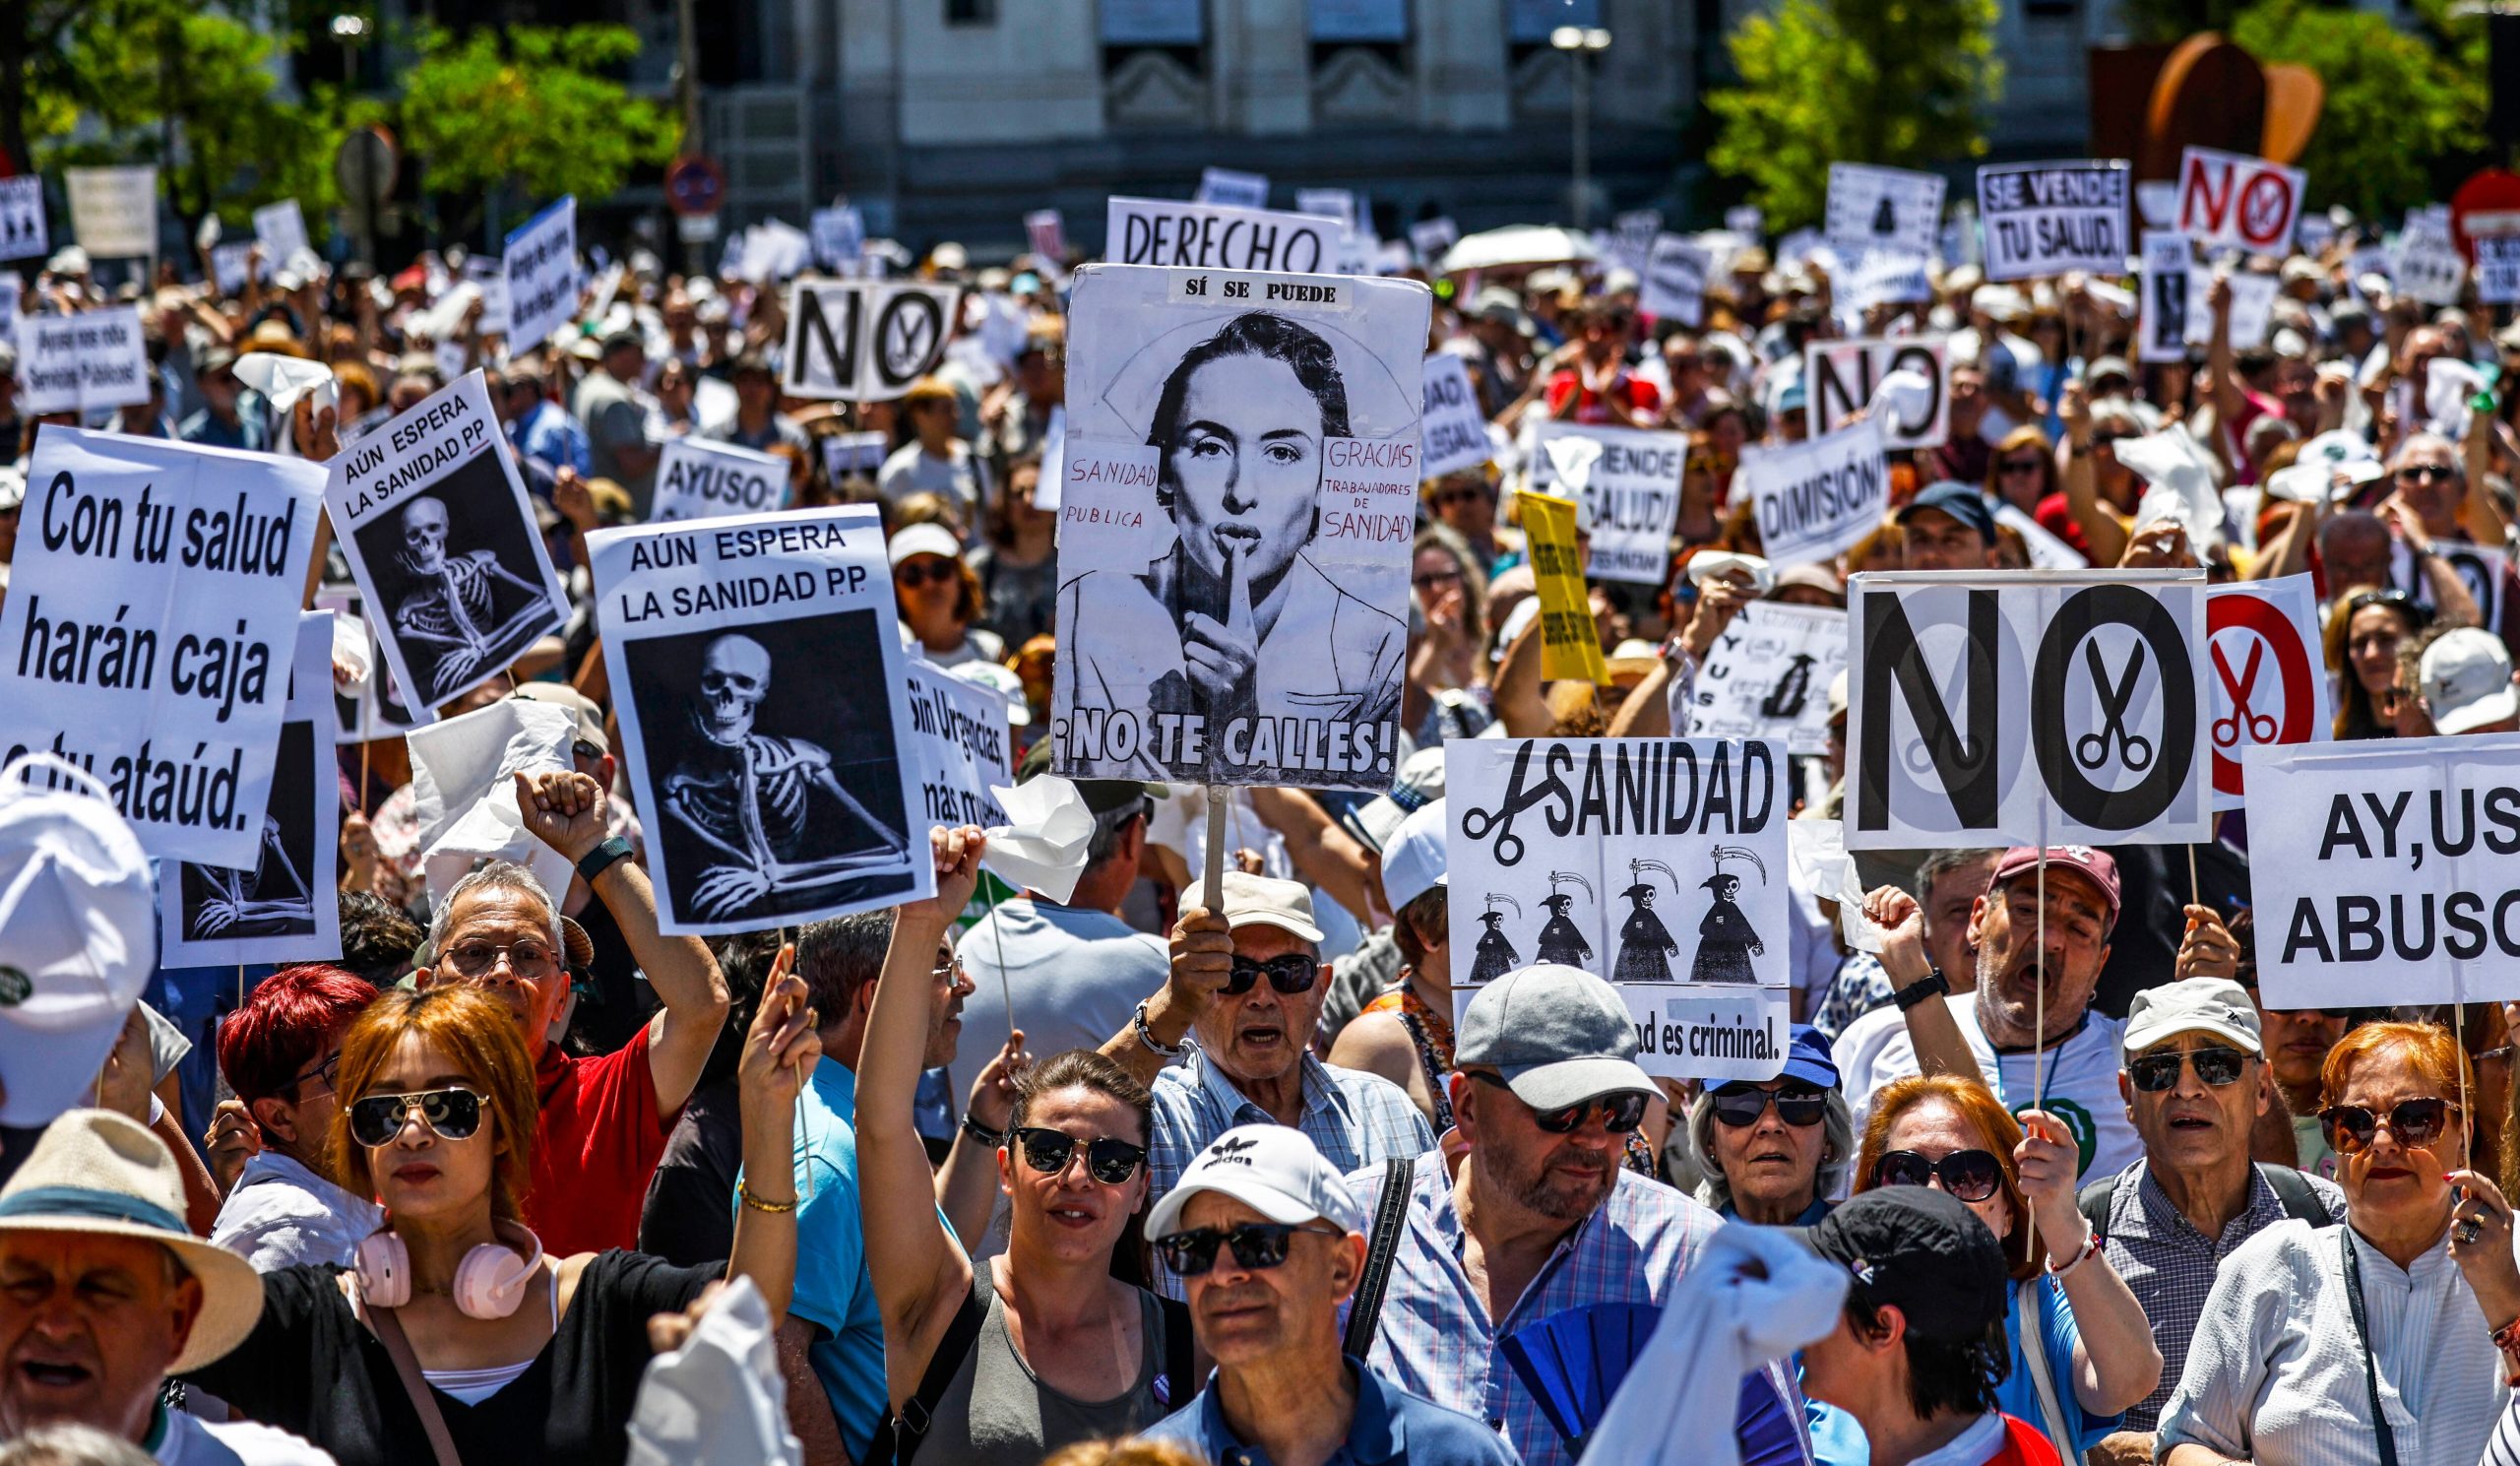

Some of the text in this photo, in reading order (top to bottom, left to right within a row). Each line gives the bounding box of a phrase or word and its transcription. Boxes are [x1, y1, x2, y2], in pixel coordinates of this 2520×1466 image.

[1985, 170, 2121, 211] SE VENDE
[2181, 158, 2293, 244] NO
[1124, 213, 1321, 273] DERECHO
[1997, 220, 2031, 262] TU
[1186, 276, 1336, 303] SÍ SE PUEDE
[793, 288, 943, 386] NO
[1816, 347, 1941, 438] NO
[345, 395, 469, 484] AÚN ESPERA
[1329, 441, 1413, 468] GRACIAS
[345, 492, 373, 520] LA
[374, 438, 461, 500] SANIDAD
[1071, 459, 1156, 486] SANIDAD
[1325, 479, 1411, 495] TRABAJADORES
[42, 470, 297, 577] Con tu salud
[1066, 506, 1142, 528] PUBLICA
[1325, 512, 1411, 542] SANIDAD
[1354, 497, 1369, 509] DE
[630, 522, 846, 572] AÚN ESPERA
[621, 590, 664, 623] LA
[673, 571, 816, 617] SANIDAD
[18, 595, 158, 690] harán
[170, 618, 270, 723] caja
[1858, 585, 2196, 831] NO
[1054, 707, 1393, 775] ¡NO TE CALLES!
[110, 739, 247, 832] ataúd.
[1544, 740, 1774, 838] SANIDAD
[1662, 1025, 1683, 1055] es
[1689, 1012, 1780, 1060] criminal.
